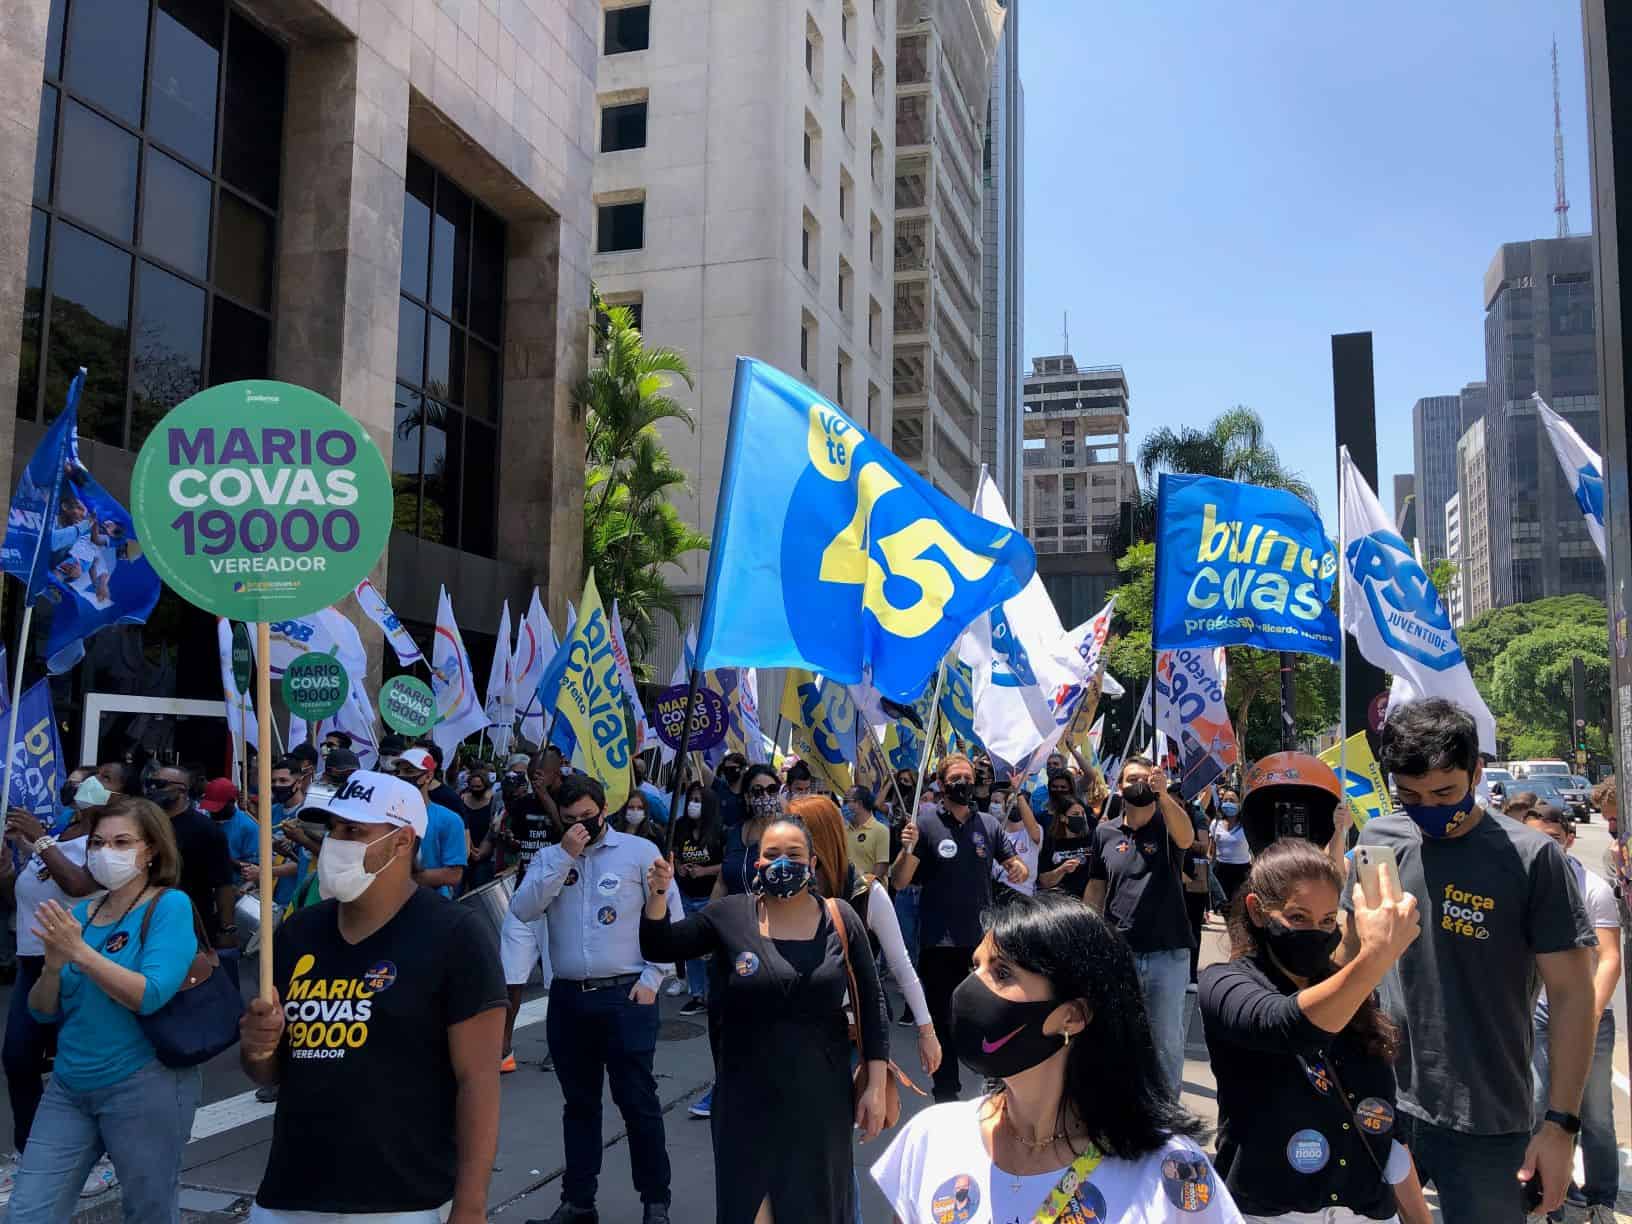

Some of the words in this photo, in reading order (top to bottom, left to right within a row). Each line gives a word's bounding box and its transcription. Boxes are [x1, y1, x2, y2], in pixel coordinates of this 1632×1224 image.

[168, 427, 357, 466] MARIO
[168, 468, 359, 508] COVAS
[170, 509, 361, 556] 19000
[210, 556, 327, 575] VEREADOR
[1387, 611, 1449, 651] JUVENTUDE
[290, 663, 340, 677] MARIO
[290, 676, 340, 689] COVAS
[292, 687, 340, 702] 19000
[391, 679, 434, 709] MARIO
[389, 689, 431, 717] COVAS
[658, 693, 704, 714] MARO
[664, 715, 711, 739] 1900
[1444, 883, 1495, 910] força
[1442, 900, 1485, 923] foco
[284, 999, 372, 1022] COVAS
